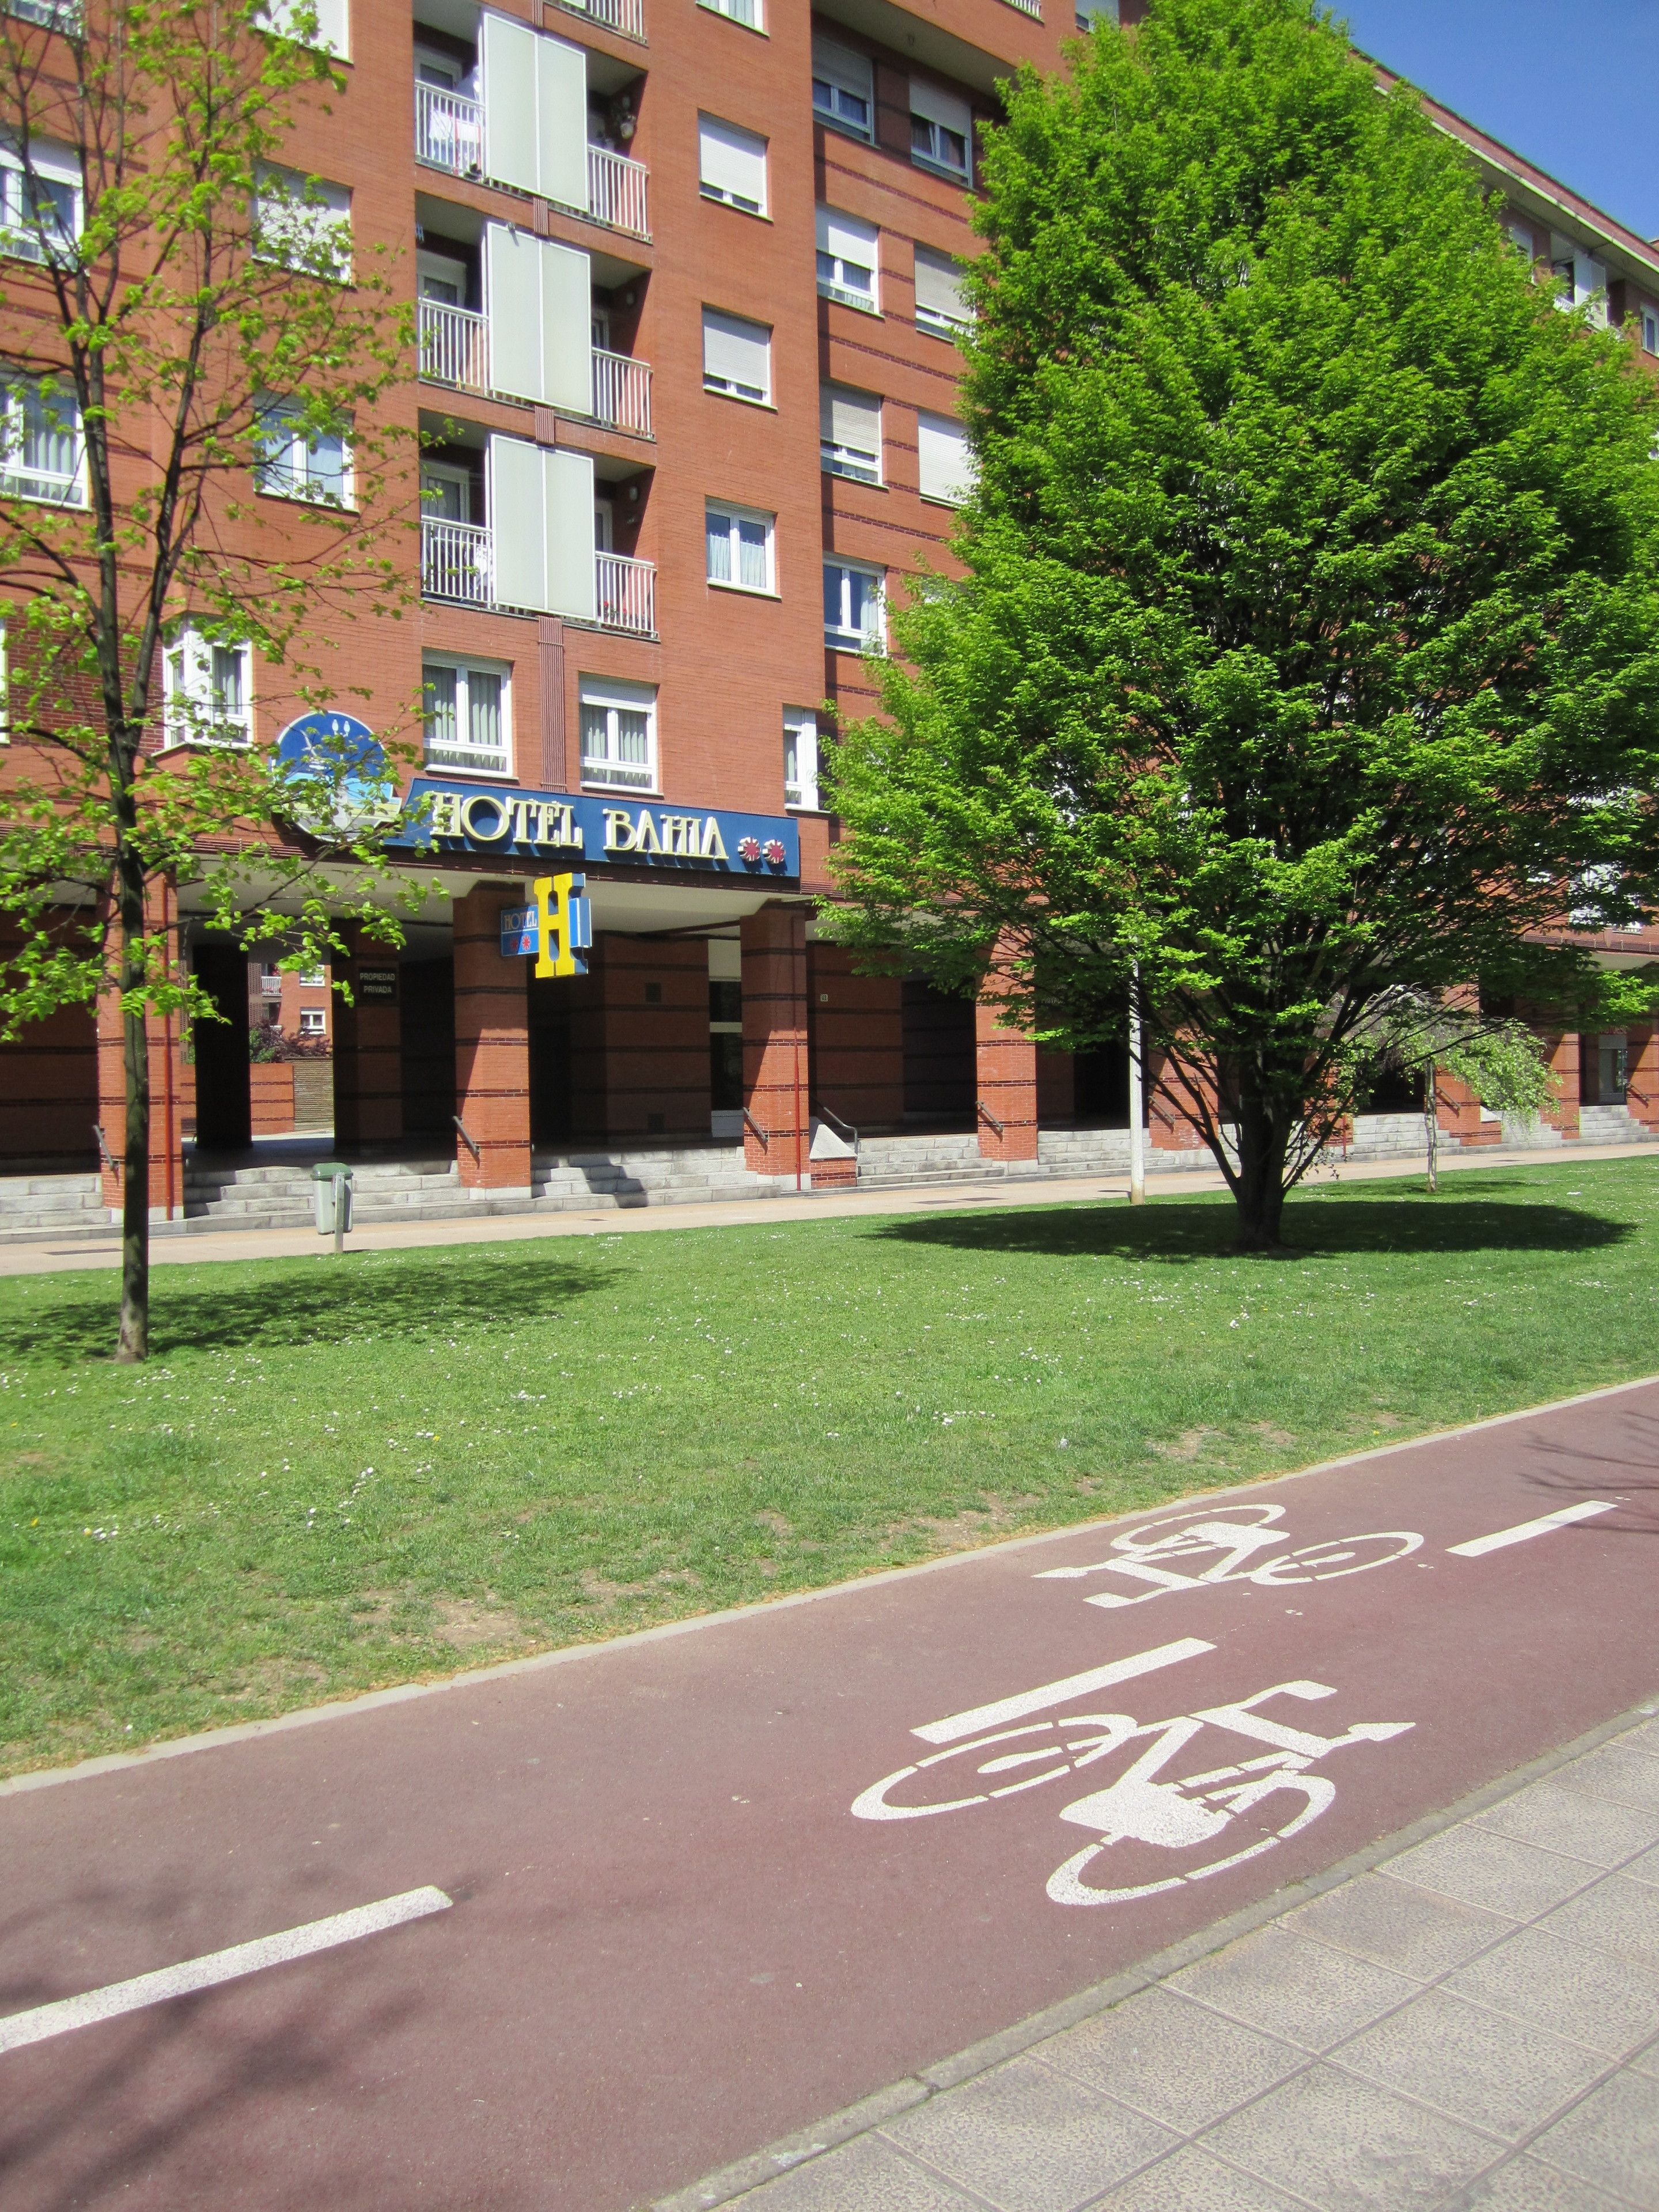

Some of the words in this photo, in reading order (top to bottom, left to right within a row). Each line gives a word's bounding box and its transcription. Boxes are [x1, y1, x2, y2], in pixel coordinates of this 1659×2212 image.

[429, 791, 583, 849] HOTEL
[603, 808, 729, 859] BAHIA
[504, 911, 537, 931] HOTEL
[534, 872, 575, 979] H
[359, 972, 395, 981] PROPIEDAD
[363, 985, 392, 993] PRIVADA
